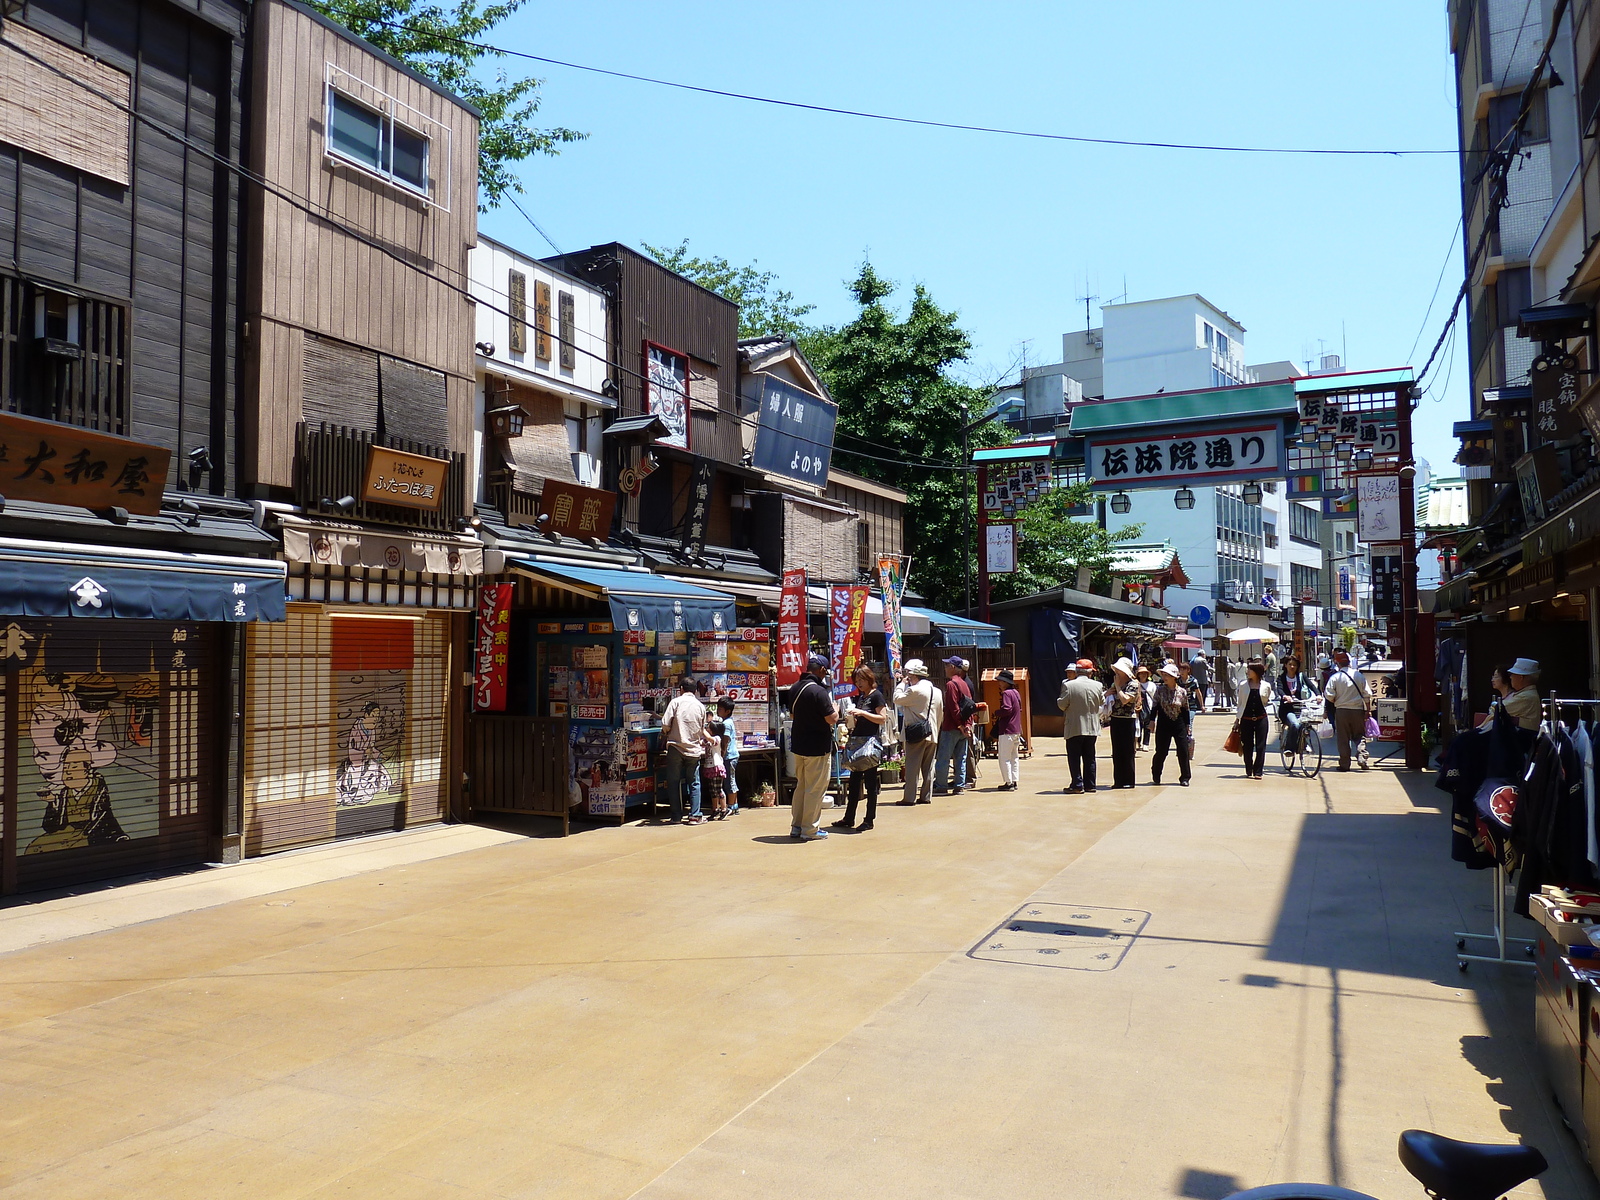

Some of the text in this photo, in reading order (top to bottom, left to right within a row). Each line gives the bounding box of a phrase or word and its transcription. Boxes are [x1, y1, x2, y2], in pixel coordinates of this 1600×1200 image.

[1557, 373, 1577, 405] 宝飾
[769, 391, 804, 424] 婦人服
[1303, 399, 1396, 450] 伝法院通り
[1537, 398, 1558, 432] 眼鏡
[14, 440, 149, 496] 大和屋
[790, 450, 822, 476] よのや
[1101, 436, 1265, 478] 伝法院通り
[373, 475, 435, 499] ふたつぼ屋
[985, 461, 1046, 508] 伝法院通り
[232, 581, 247, 617] 佃煮
[171, 628, 188, 668] 佃煮
[780, 594, 803, 673] 発売中
[729, 689, 754, 700] 6/4
[579, 707, 605, 718] 発売中
